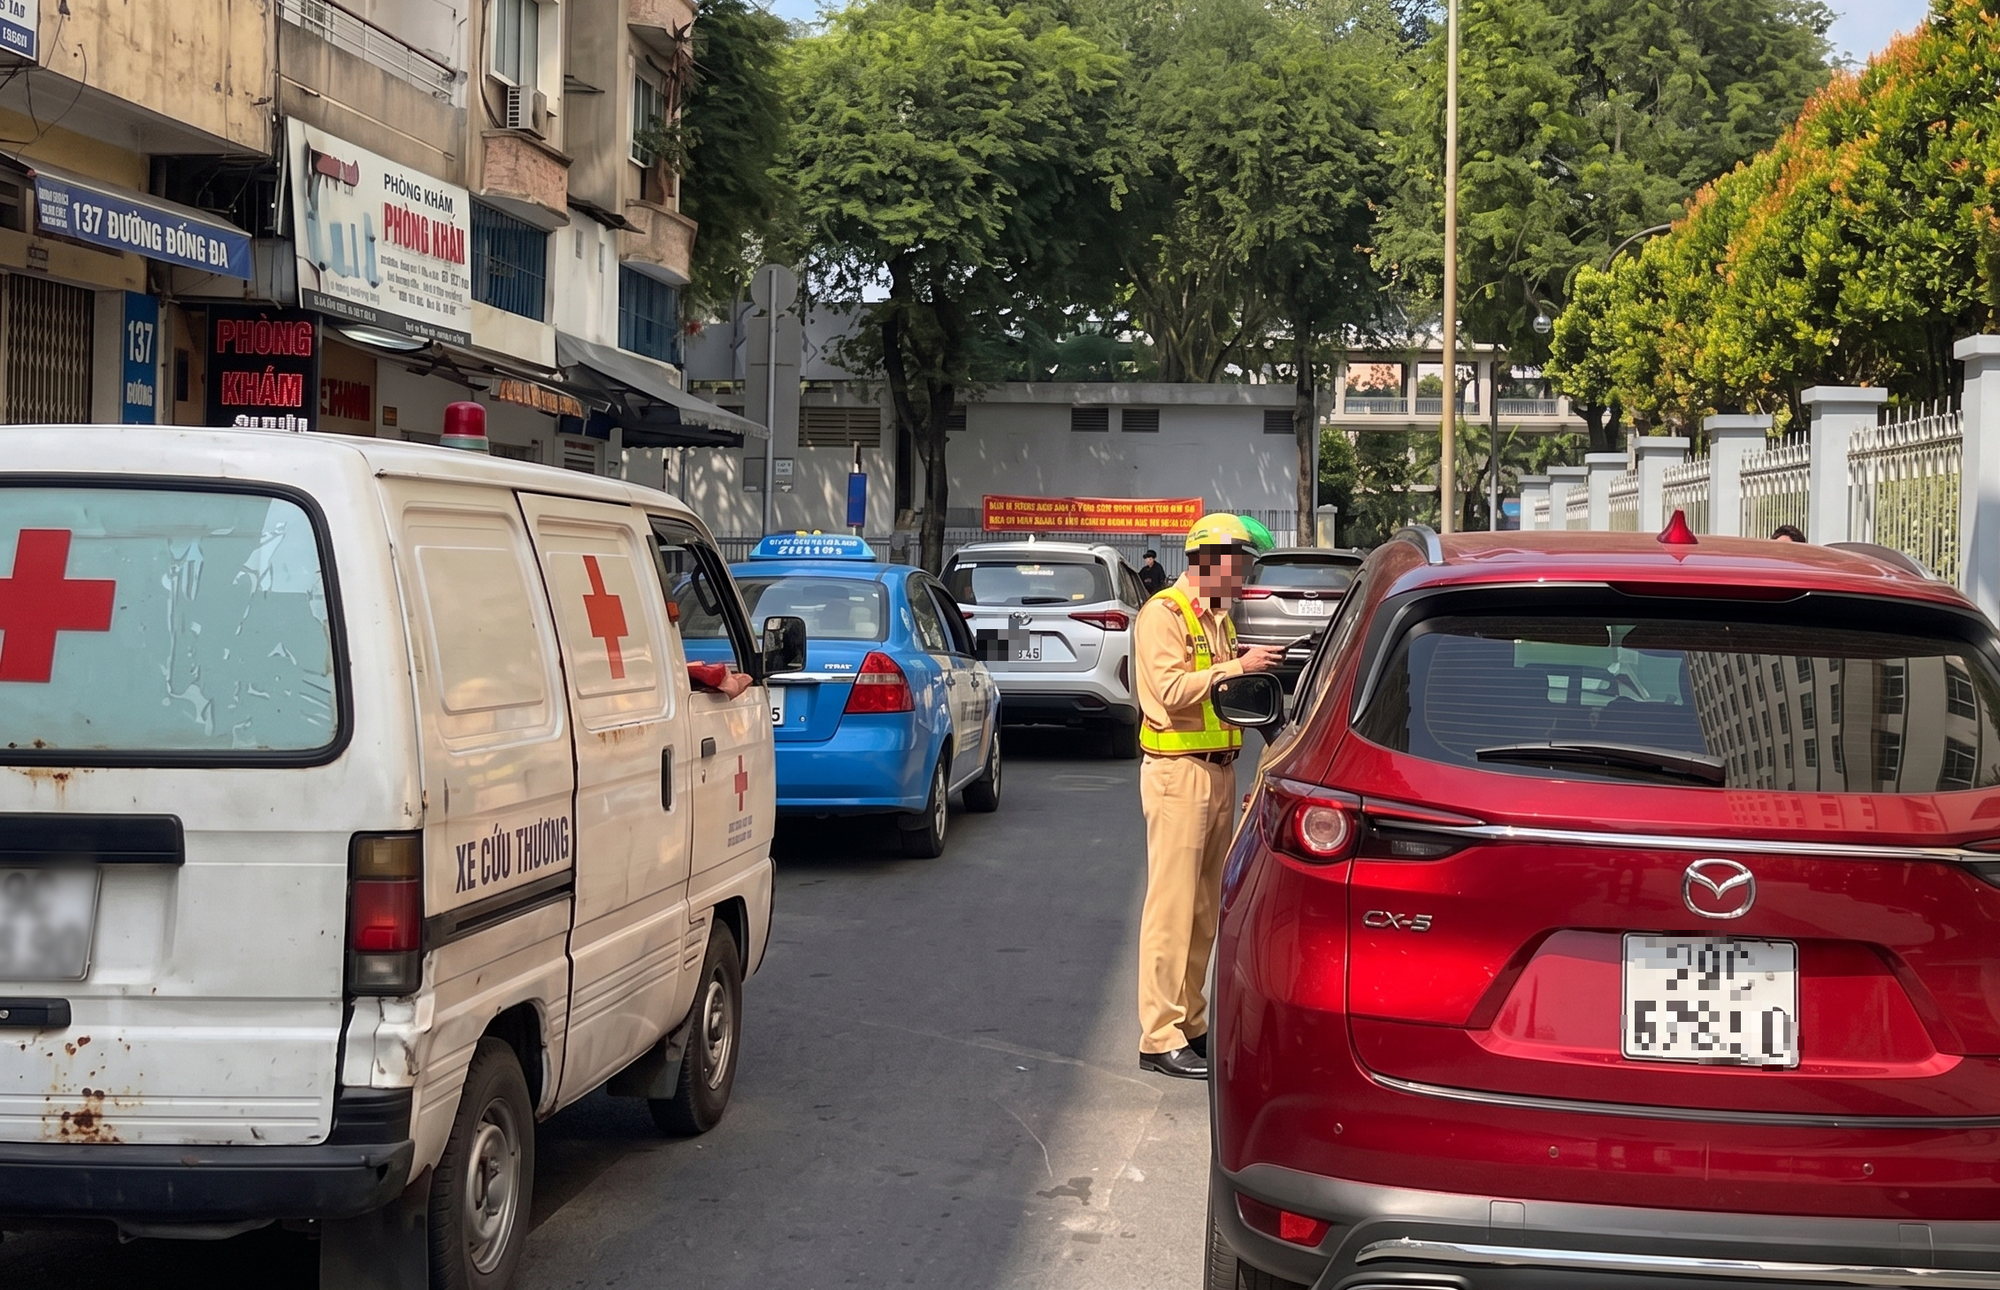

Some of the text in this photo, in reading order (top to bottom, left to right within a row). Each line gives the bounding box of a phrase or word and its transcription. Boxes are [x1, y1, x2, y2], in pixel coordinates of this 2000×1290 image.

[384, 173, 453, 214] PHÒNG KHÁM
[73, 202, 103, 235] 137
[107, 210, 162, 252] ĐƯỜNG
[165, 222, 206, 263] ĐỐNG
[208, 238, 229, 269] ĐA
[384, 202, 430, 255] PHÒNG
[128, 320, 154, 364] 137
[216, 312, 313, 357] PHÒNG
[221, 365, 304, 408] KHÁM
[455, 815, 570, 895] XE CỨU THƯƠNG
[1362, 909, 1433, 932] CX-5
